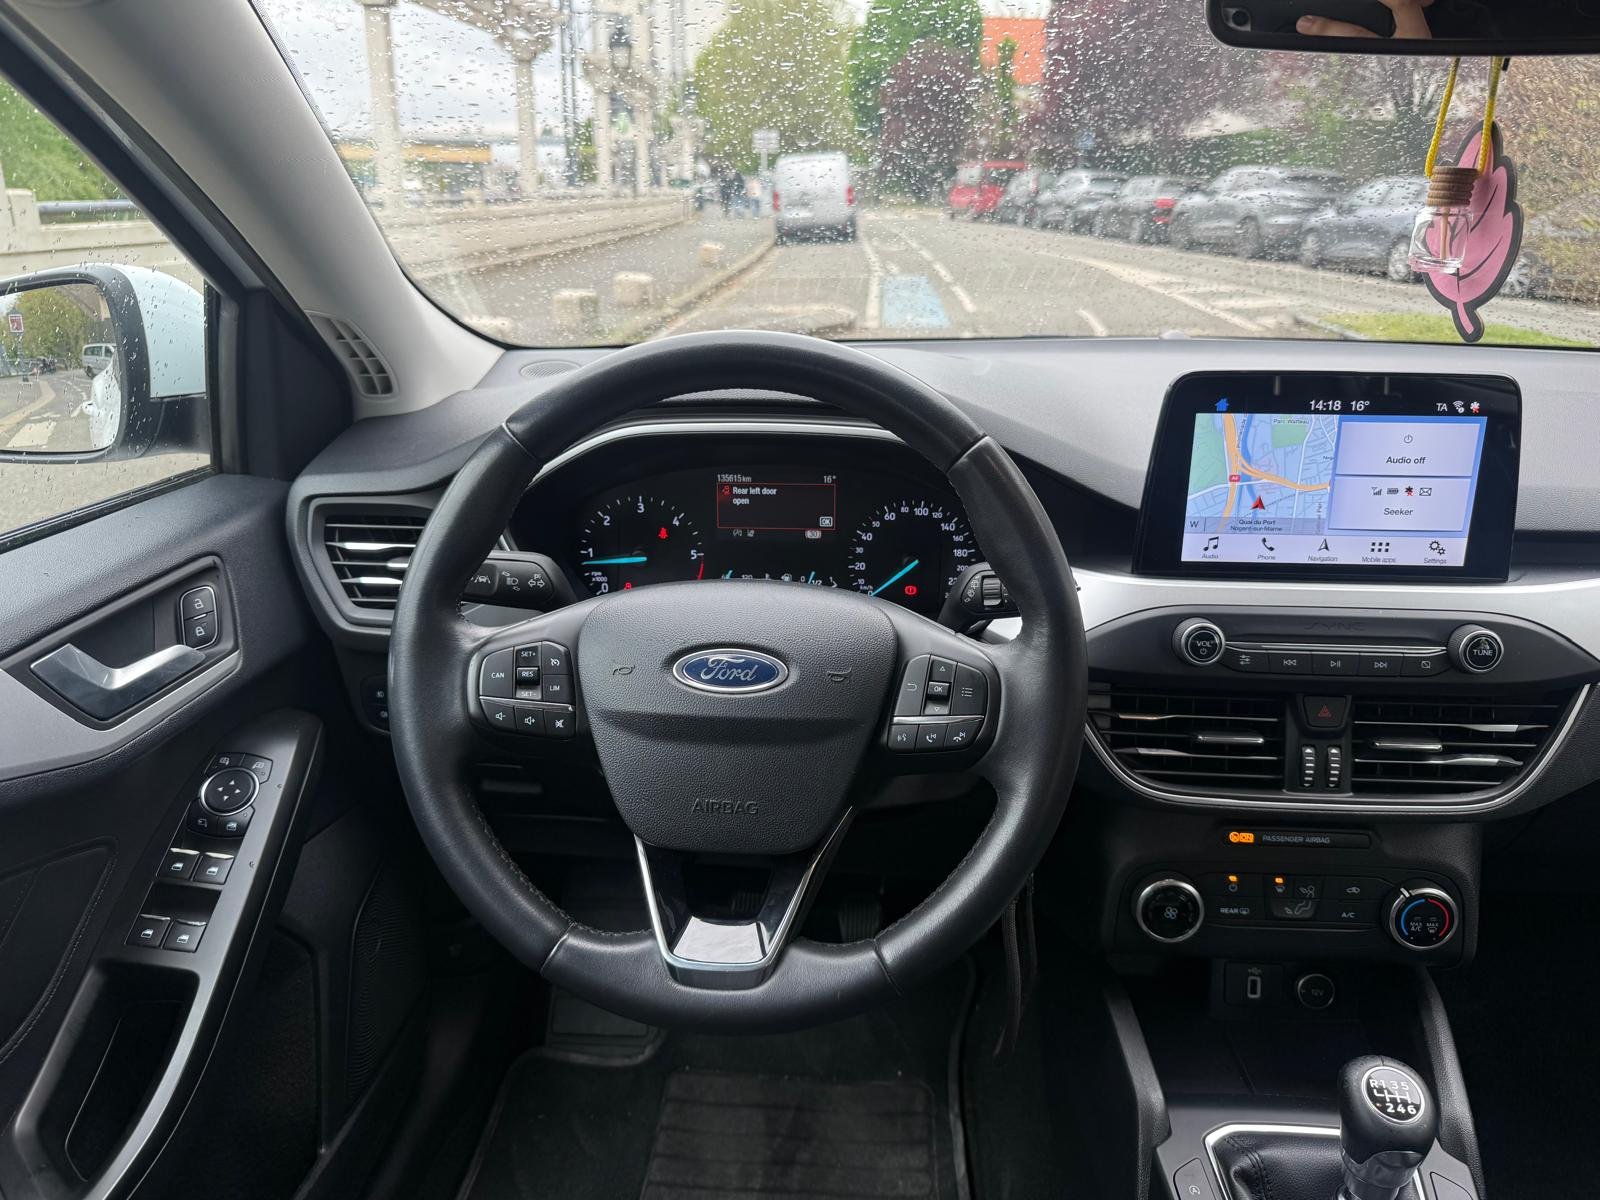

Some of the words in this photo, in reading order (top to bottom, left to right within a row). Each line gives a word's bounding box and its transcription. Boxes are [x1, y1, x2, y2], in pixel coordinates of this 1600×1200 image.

[1310, 400, 1341, 411] 14:18
[1350, 400, 1370, 411] 16°
[1436, 403, 1448, 412] TA
[1386, 456, 1412, 464] Audio
[1414, 456, 1426, 464] off
[732, 486, 748, 495] Rear
[750, 487, 760, 495] left
[637, 503, 644, 513] 3
[914, 507, 928, 516] 100
[603, 516, 611, 526] 2
[672, 516, 680, 526] 4
[884, 512, 896, 521] 60
[941, 523, 955, 531] 140
[861, 532, 873, 541] 40
[588, 548, 593, 558] 1
[690, 550, 697, 560] 5
[953, 549, 968, 557] 180
[855, 562, 866, 570] 20
[601, 583, 608, 593] 0
[1473, 649, 1493, 657] TUNE
[700, 656, 757, 682] Ford
[691, 798, 759, 815] AIRBAG
[1369, 1079, 1378, 1088] R
[1390, 1080, 1398, 1089] 3
[1401, 1081, 1409, 1090] 5
[1386, 1103, 1395, 1112] 2
[1397, 1104, 1406, 1114] 4
[1407, 1105, 1417, 1114] 6
